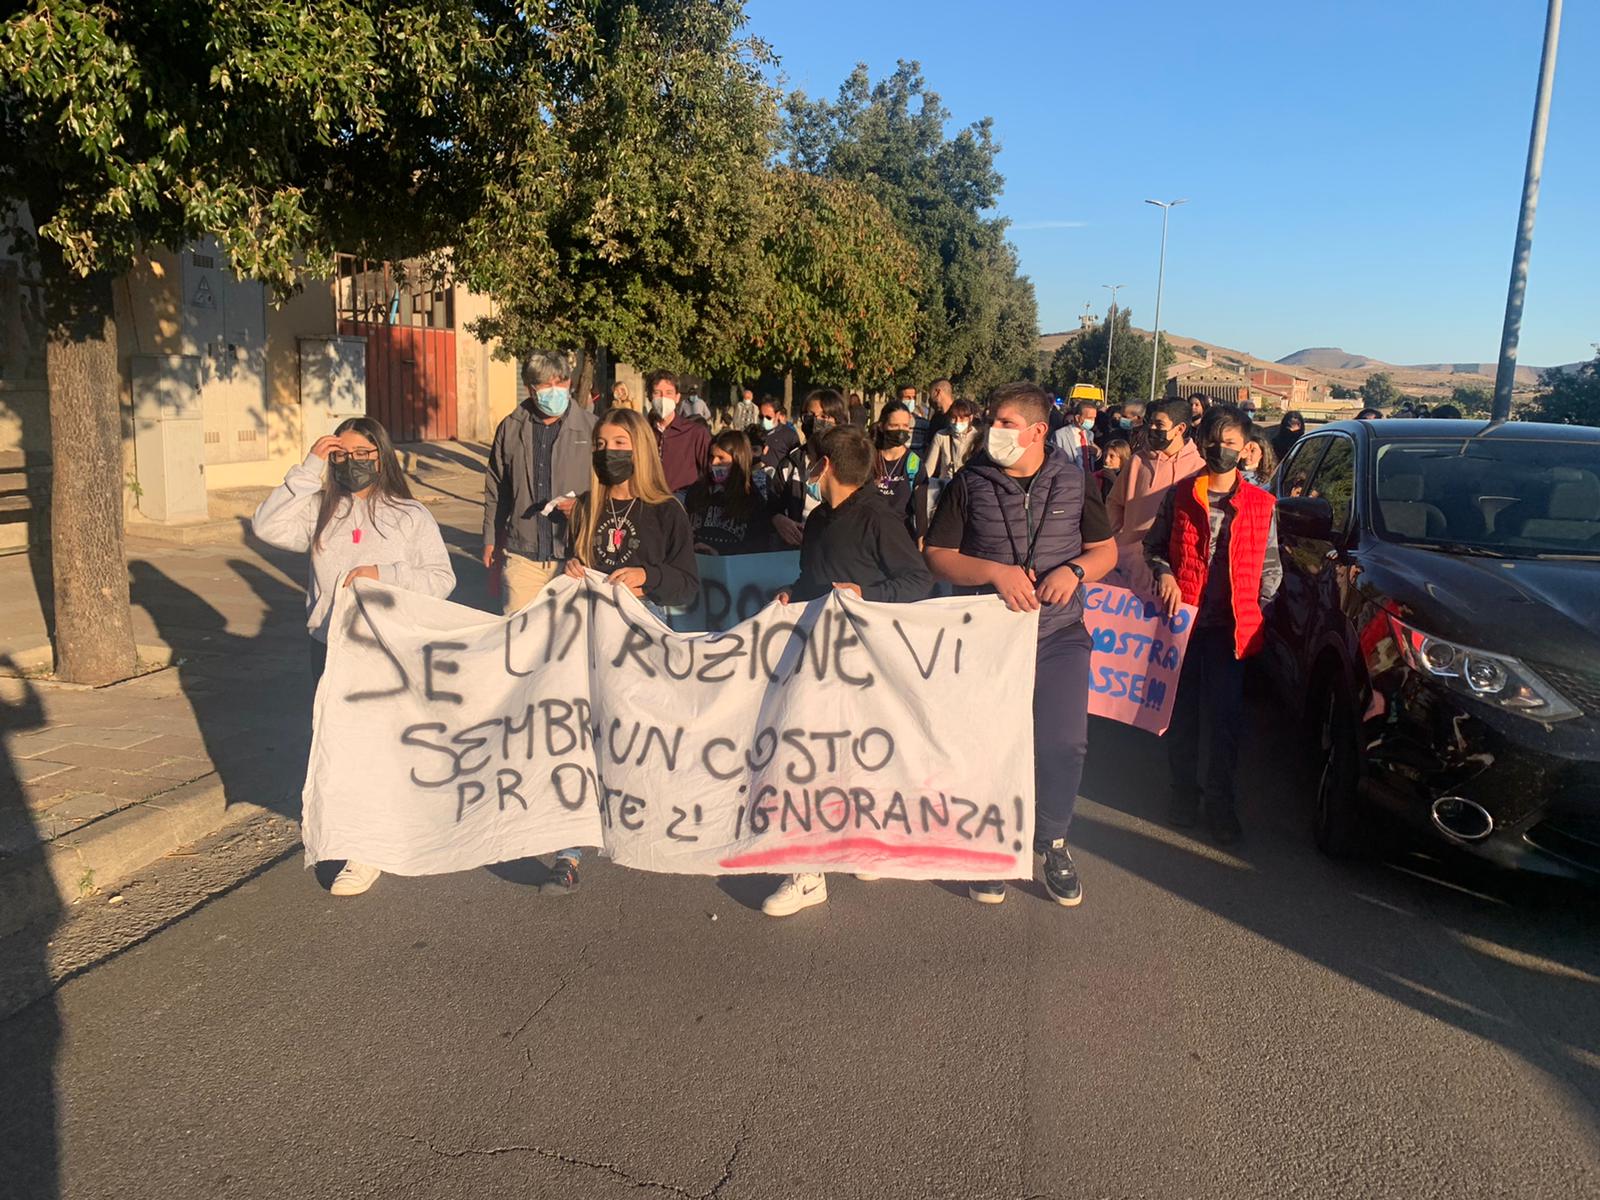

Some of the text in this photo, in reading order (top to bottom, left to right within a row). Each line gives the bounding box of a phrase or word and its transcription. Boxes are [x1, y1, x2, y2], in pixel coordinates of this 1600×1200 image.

[344, 588, 469, 704] SE
[401, 698, 894, 788] SEMBR UN COSTO
